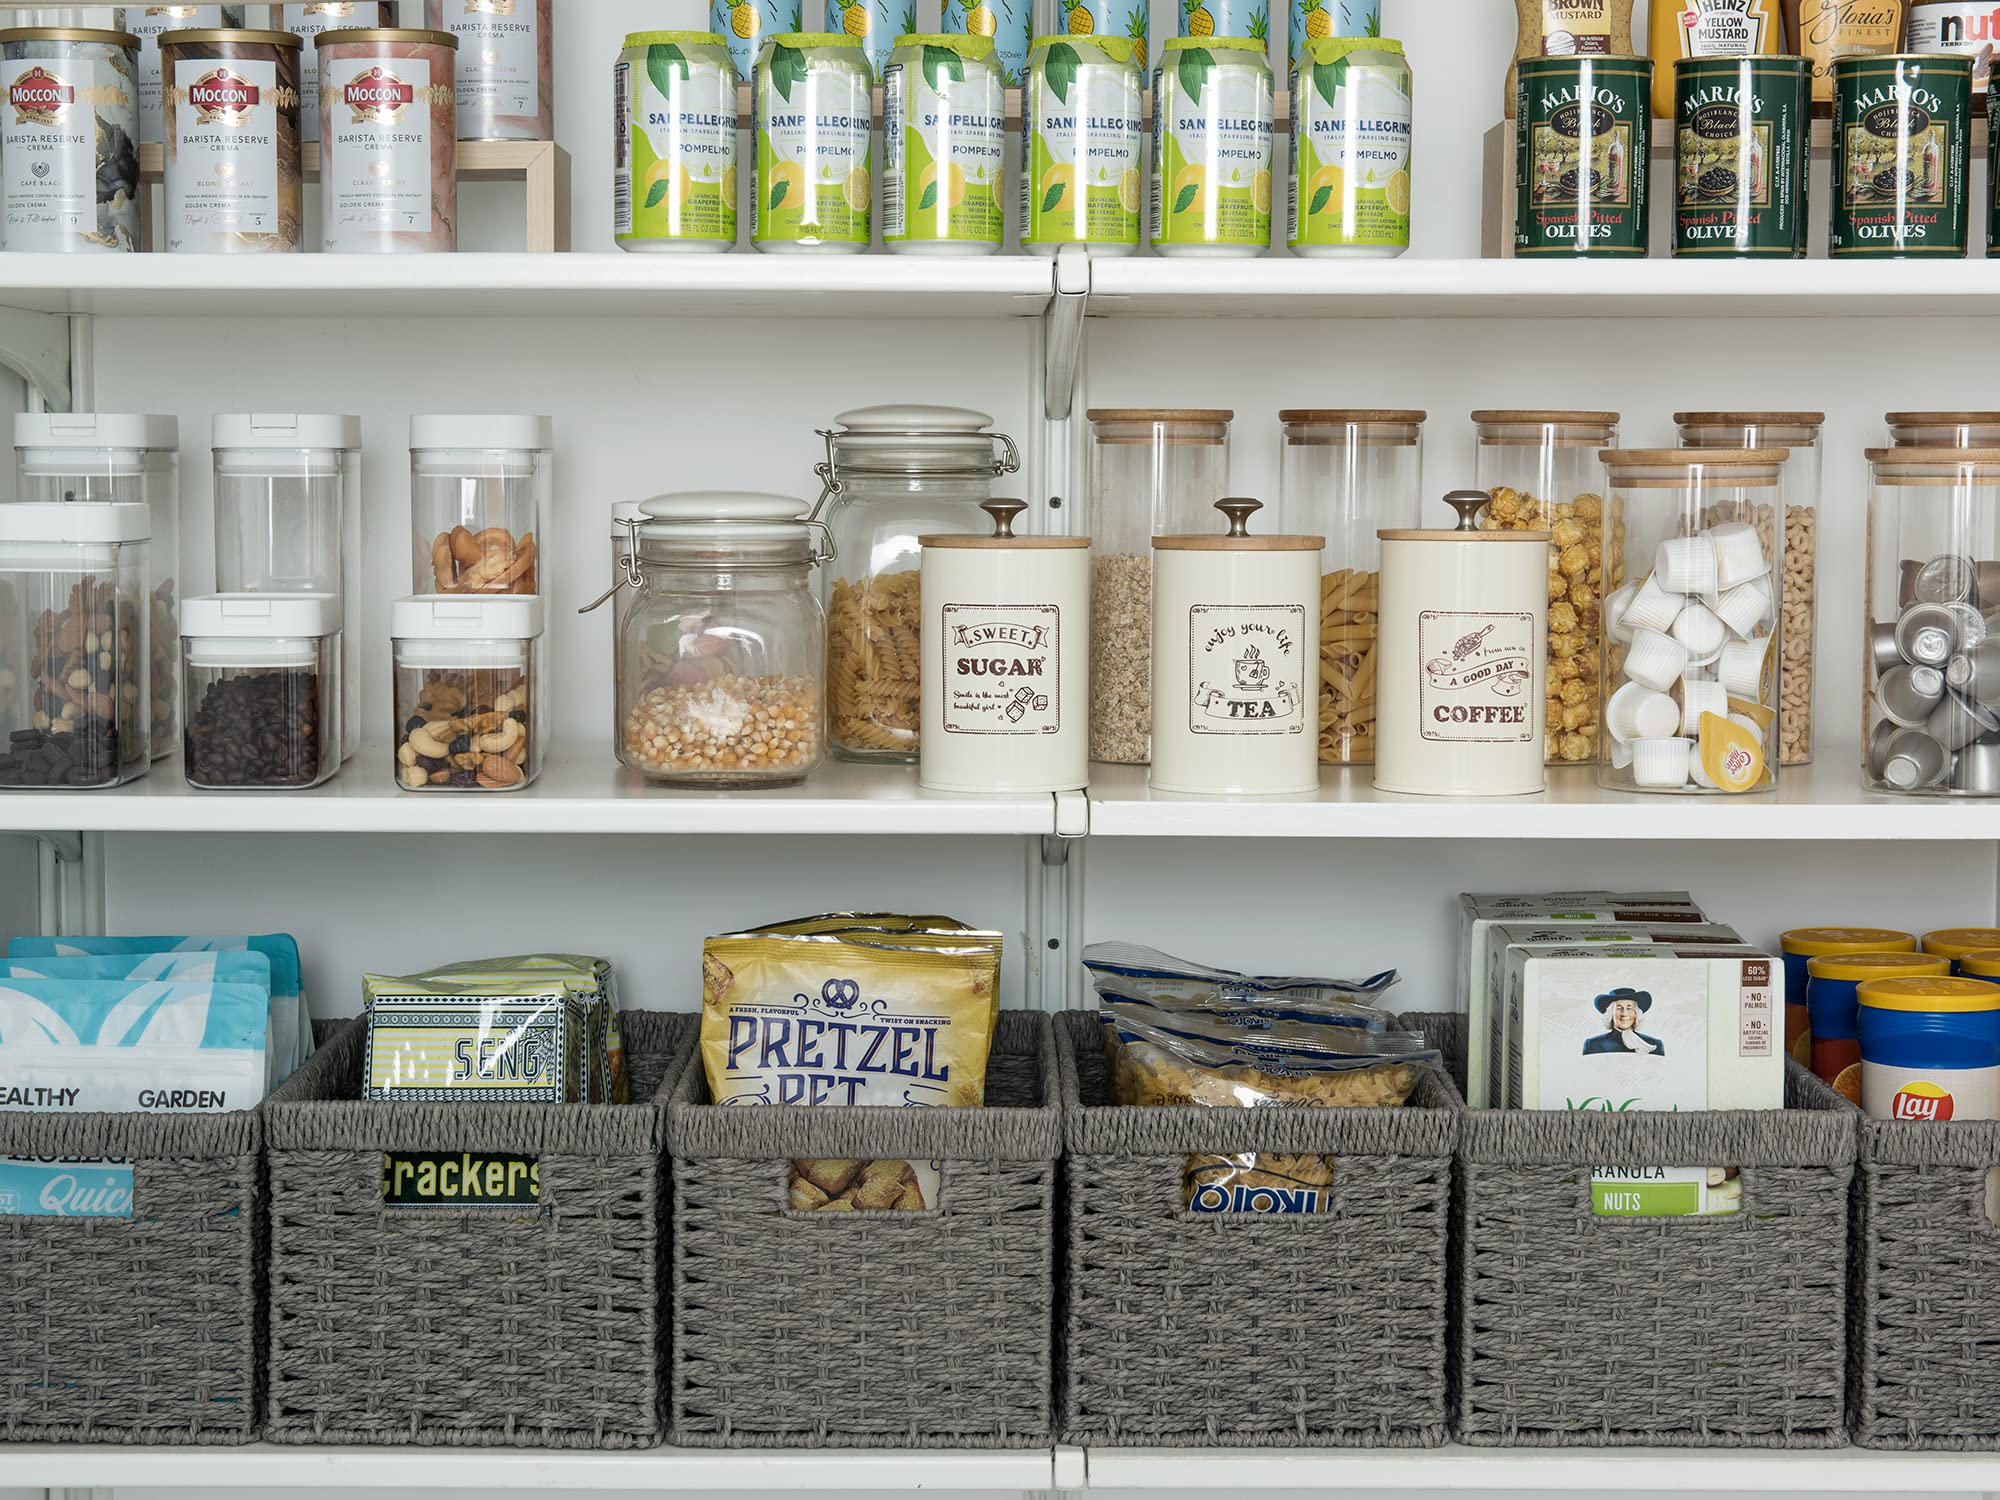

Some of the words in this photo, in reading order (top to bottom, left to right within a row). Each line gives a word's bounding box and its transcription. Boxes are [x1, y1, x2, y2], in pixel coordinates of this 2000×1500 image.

[1548, 0, 1604, 11] BROWN
[1703, 0, 1747, 13] HEINZ
[1550, 11, 1602, 20] MUSTARD
[451, 24, 489, 32] BARISTA
[491, 24, 531, 32] RESERVE
[1705, 18, 1743, 27] YELLOW
[133, 26, 168, 34] BARISTA
[291, 25, 327, 33] BARISTA
[1698, 28, 1748, 40] MUSTARD
[1853, 45, 1876, 54] Honey
[12, 88, 61, 102] MOCCON
[193, 87, 248, 102] MOCCON
[347, 87, 401, 102] MOCCON
[518, 101, 524, 109] 7
[1699, 110, 1739, 121] HOJIBLANC
[771, 115, 870, 131] SANPLLEGRINO
[1180, 118, 1273, 134] SANELLEGRINO
[1700, 119, 1738, 131] Black
[6, 135, 37, 144] BARISTA
[40, 134, 86, 143] RESERVE
[183, 135, 222, 143] BARISTA
[225, 135, 269, 144] RESERVE
[338, 134, 376, 143] BARISTA
[1705, 131, 1734, 139] CHOICE
[1073, 147, 1129, 158] PMPELMO
[1217, 149, 1262, 160] OMPELMO
[1340, 150, 1398, 160] PMPELMO
[71, 217, 78, 225] 9
[255, 217, 261, 225] 5
[408, 215, 414, 224] 7
[1590, 211, 1624, 224] Pitted
[1679, 211, 1718, 229] Spanish
[1848, 211, 1895, 229] Spanish
[1904, 211, 1937, 224] Pitted
[1545, 224, 1612, 238] OLIVES
[1686, 225, 1748, 239] OLIVES
[1858, 224, 1926, 239] OLIVES
[973, 627, 1030, 643] SWEET
[1205, 623, 1236, 653] enjoy
[1241, 622, 1273, 635] your
[1276, 629, 1294, 657] life
[957, 658, 1043, 676] SUGAR
[1450, 678, 1458, 686] A
[1463, 667, 1492, 684] GOOD
[1495, 660, 1514, 673] DAY
[953, 690, 973, 699] Smile
[982, 691, 992, 699] the
[953, 702, 980, 711] beautiful
[982, 703, 995, 712] girl
[1227, 700, 1276, 718] TEA
[1433, 705, 1525, 723] COFFEE
[1748, 966, 1765, 975] 60%
[1751, 993, 1761, 1001] NO
[761, 1008, 799, 1016] FLAVORFUL
[1750, 1020, 1761, 1029] NO
[726, 1015, 949, 1083] PRETZEL
[454, 1037, 541, 1081] SENG
[0, 1087, 80, 1106] EALTHY
[138, 1089, 226, 1109] GARDEN
[1897, 1094, 1939, 1120] Lay
[40, 1174, 133, 1216] Quic
[1604, 1192, 1641, 1211] NUTS
